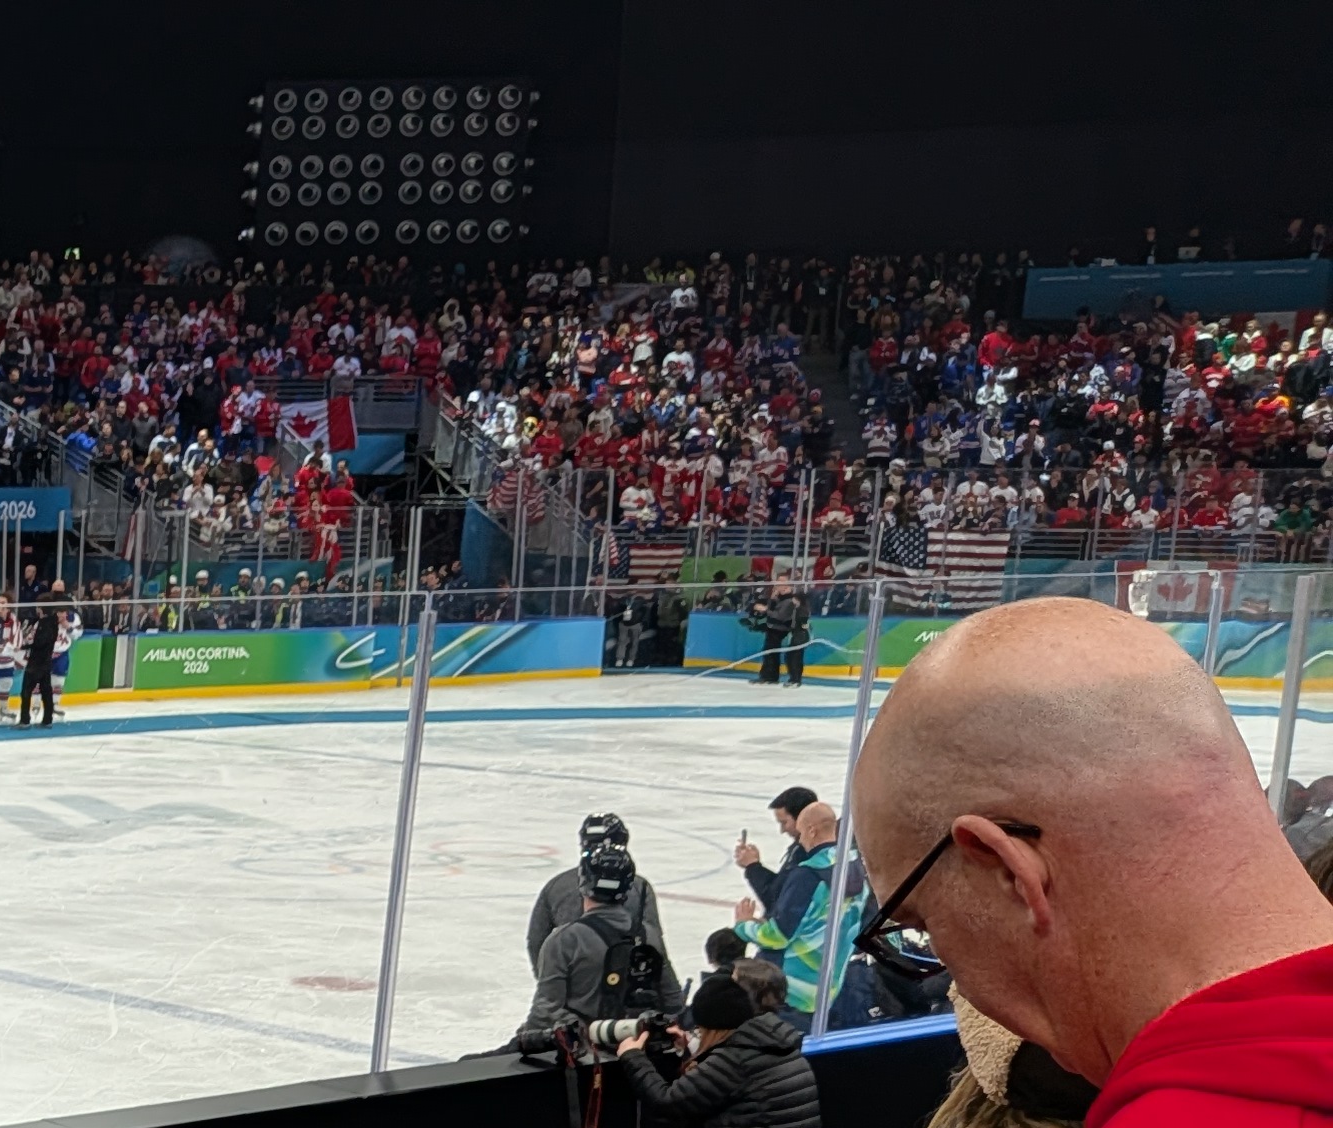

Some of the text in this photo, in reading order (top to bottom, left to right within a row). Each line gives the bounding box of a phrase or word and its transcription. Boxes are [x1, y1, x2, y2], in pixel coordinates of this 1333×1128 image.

[0, 499, 36, 520] 2026
[142, 646, 250, 662] MILANO CORTINA
[183, 661, 210, 674] 2026
